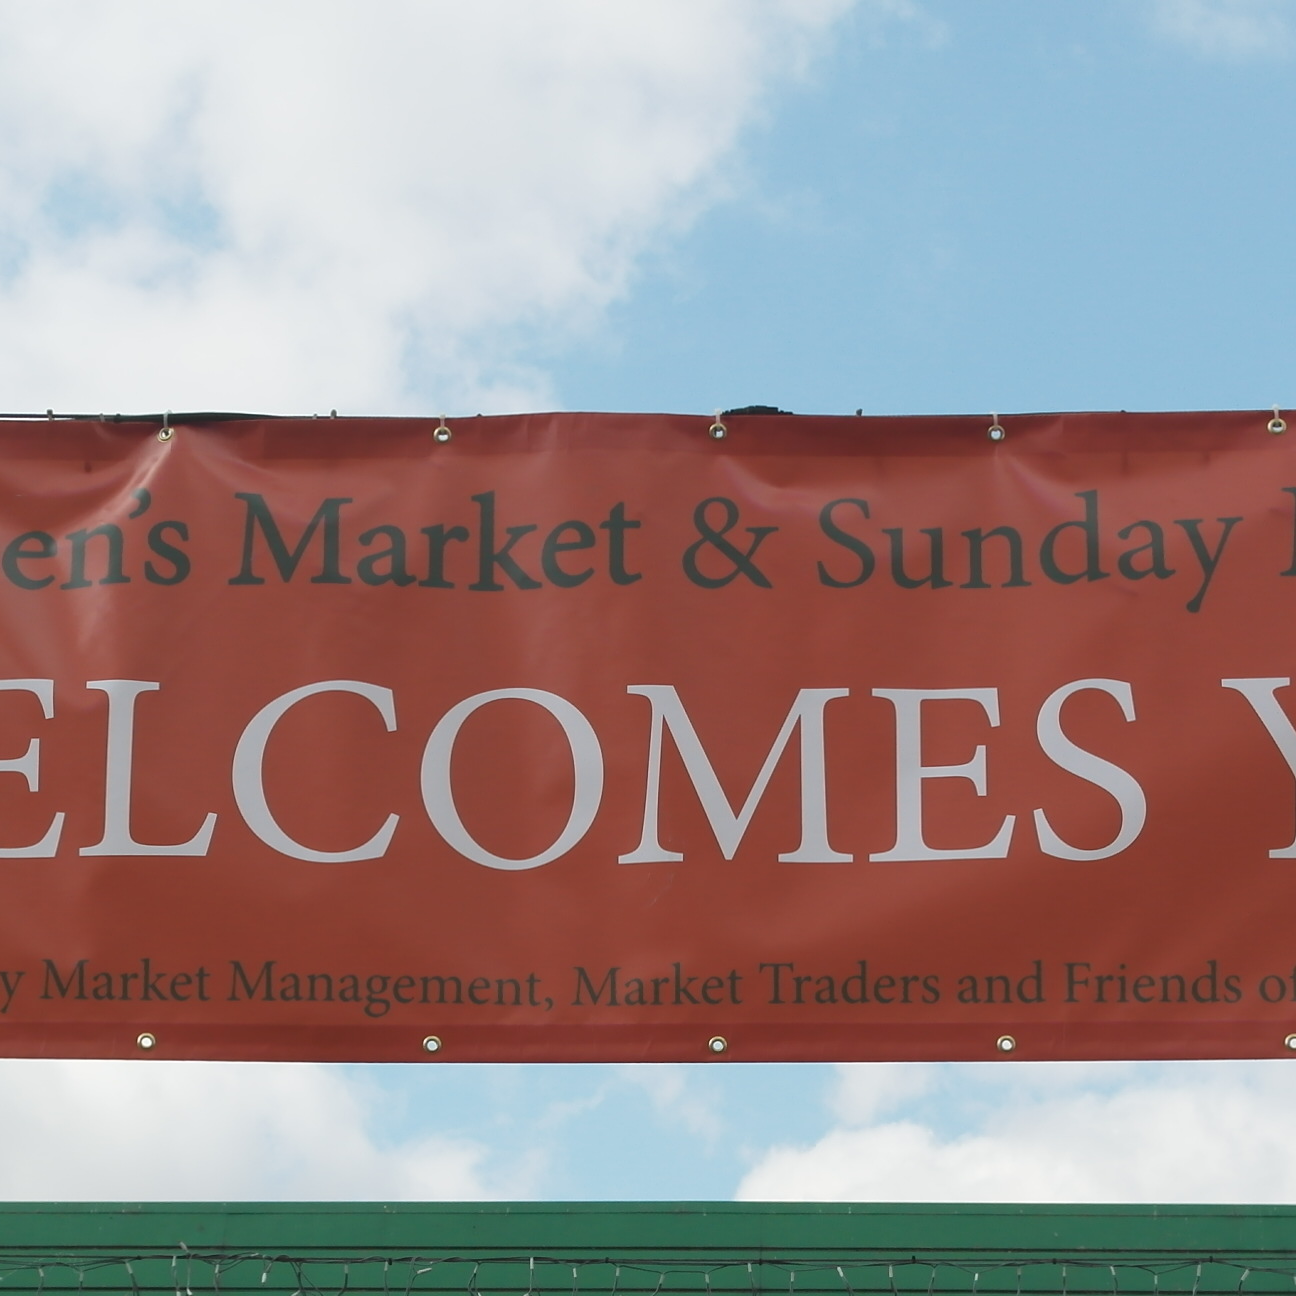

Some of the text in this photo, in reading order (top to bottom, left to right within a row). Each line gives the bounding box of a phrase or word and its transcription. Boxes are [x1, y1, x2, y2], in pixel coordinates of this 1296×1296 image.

[227, 490, 644, 593] Market
[680, 495, 780, 591] &
[816, 488, 1244, 615] Sunday
[38, 957, 211, 1003] Market
[226, 959, 556, 1020] Management,
[570, 961, 744, 1008] Market
[758, 958, 942, 1007] Traders
[956, 958, 1047, 1006] and
[1062, 958, 1243, 1005] Friends
